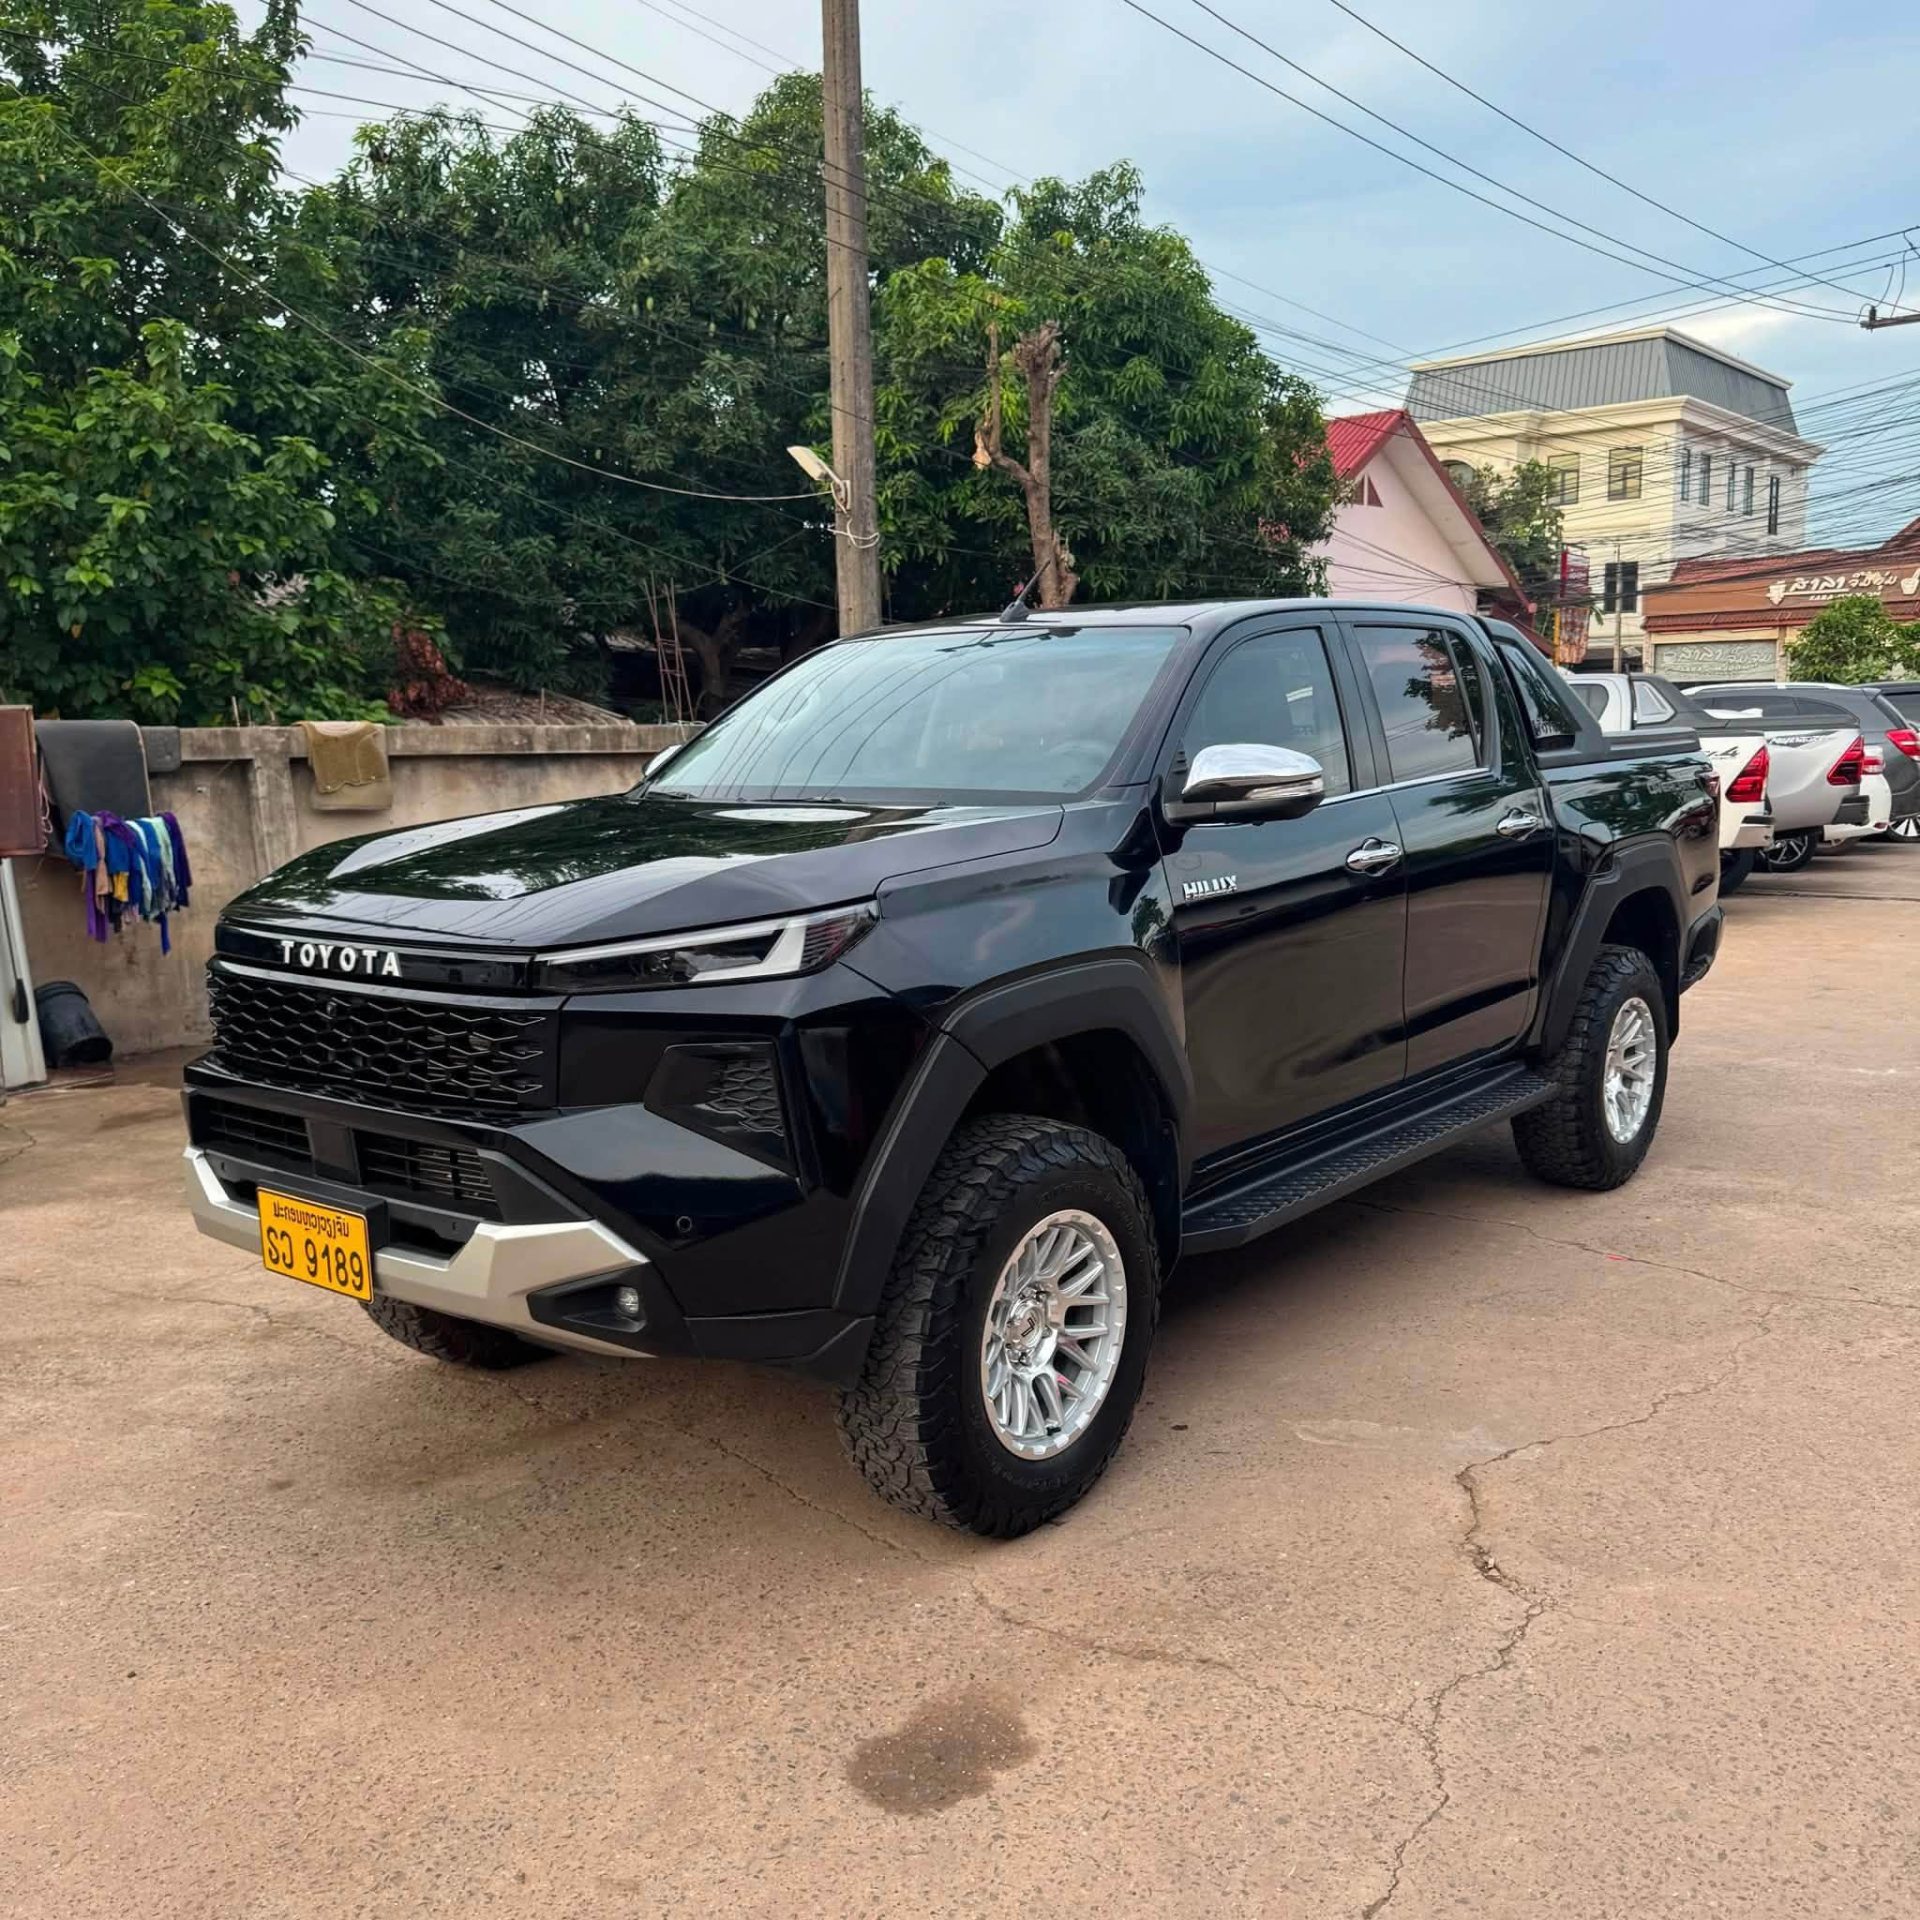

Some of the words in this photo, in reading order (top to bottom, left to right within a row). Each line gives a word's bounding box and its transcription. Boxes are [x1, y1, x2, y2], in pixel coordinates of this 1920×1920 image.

[1182, 874, 1238, 899] HILUX
[281, 940, 401, 977] TOYOTA
[304, 1238, 364, 1292] 9189
